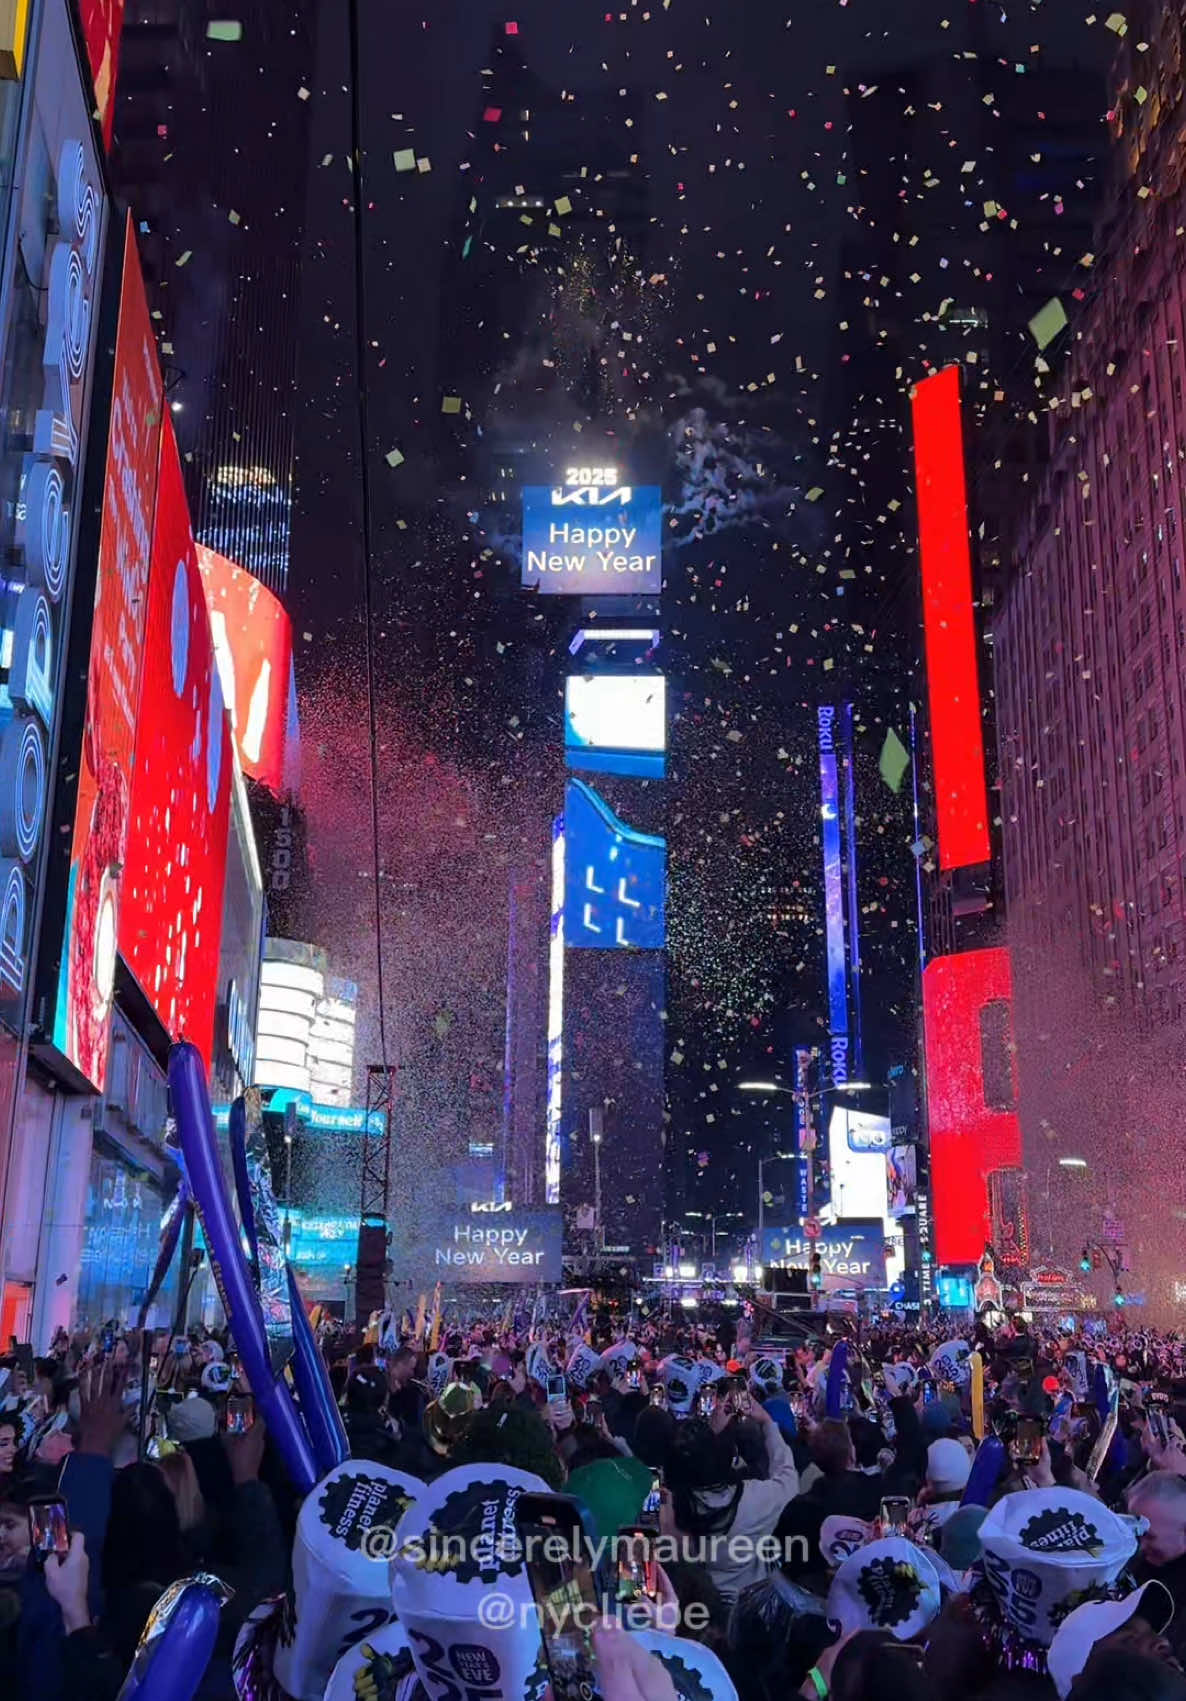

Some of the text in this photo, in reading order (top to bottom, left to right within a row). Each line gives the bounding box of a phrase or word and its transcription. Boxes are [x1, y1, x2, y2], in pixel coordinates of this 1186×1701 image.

[565, 467, 618, 486] 2025
[551, 486, 633, 506] KIA
[549, 522, 637, 549] Happy
[527, 551, 657, 573] New Year
[471, 1200, 513, 1212] KIA
[917, 1194, 929, 1244] SQUARE
[454, 1225, 528, 1246] Happy
[435, 1248, 545, 1265] New Year
[821, 1259, 871, 1275] Year
[336, 1481, 370, 1537] fitness
[357, 1481, 388, 1533] planet
[478, 1499, 500, 1572] planet
[463, 1669, 494, 1681] EVE
